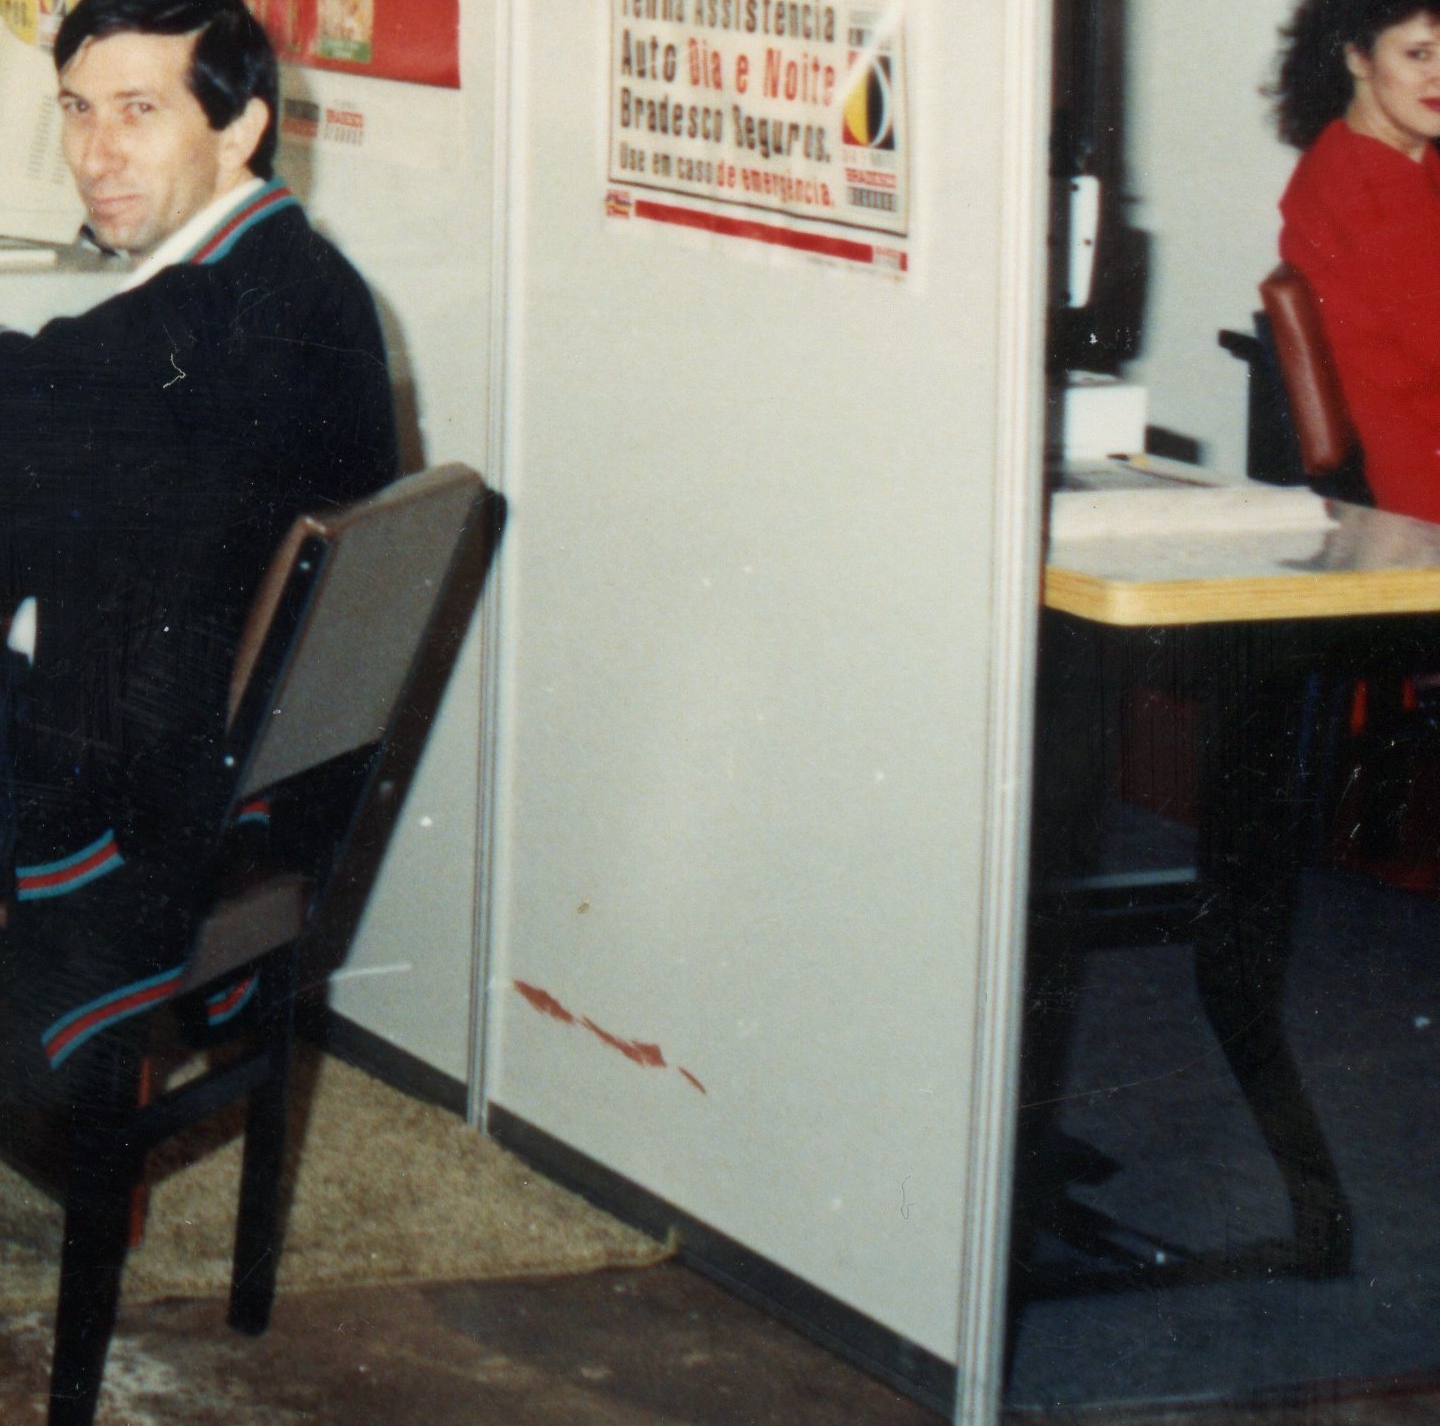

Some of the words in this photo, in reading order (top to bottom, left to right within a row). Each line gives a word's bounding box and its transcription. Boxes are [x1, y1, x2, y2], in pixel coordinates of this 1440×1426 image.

[621, 27, 678, 84] Auto
[688, 36, 723, 90] Dia
[735, 52, 750, 95] e
[763, 46, 836, 108] Noite
[619, 140, 645, 173] Use
[652, 147, 672, 175] em
[676, 151, 713, 185] caso
[716, 155, 737, 189] de
[621, 86, 723, 145] Bradesco
[731, 103, 832, 165] Seguros.
